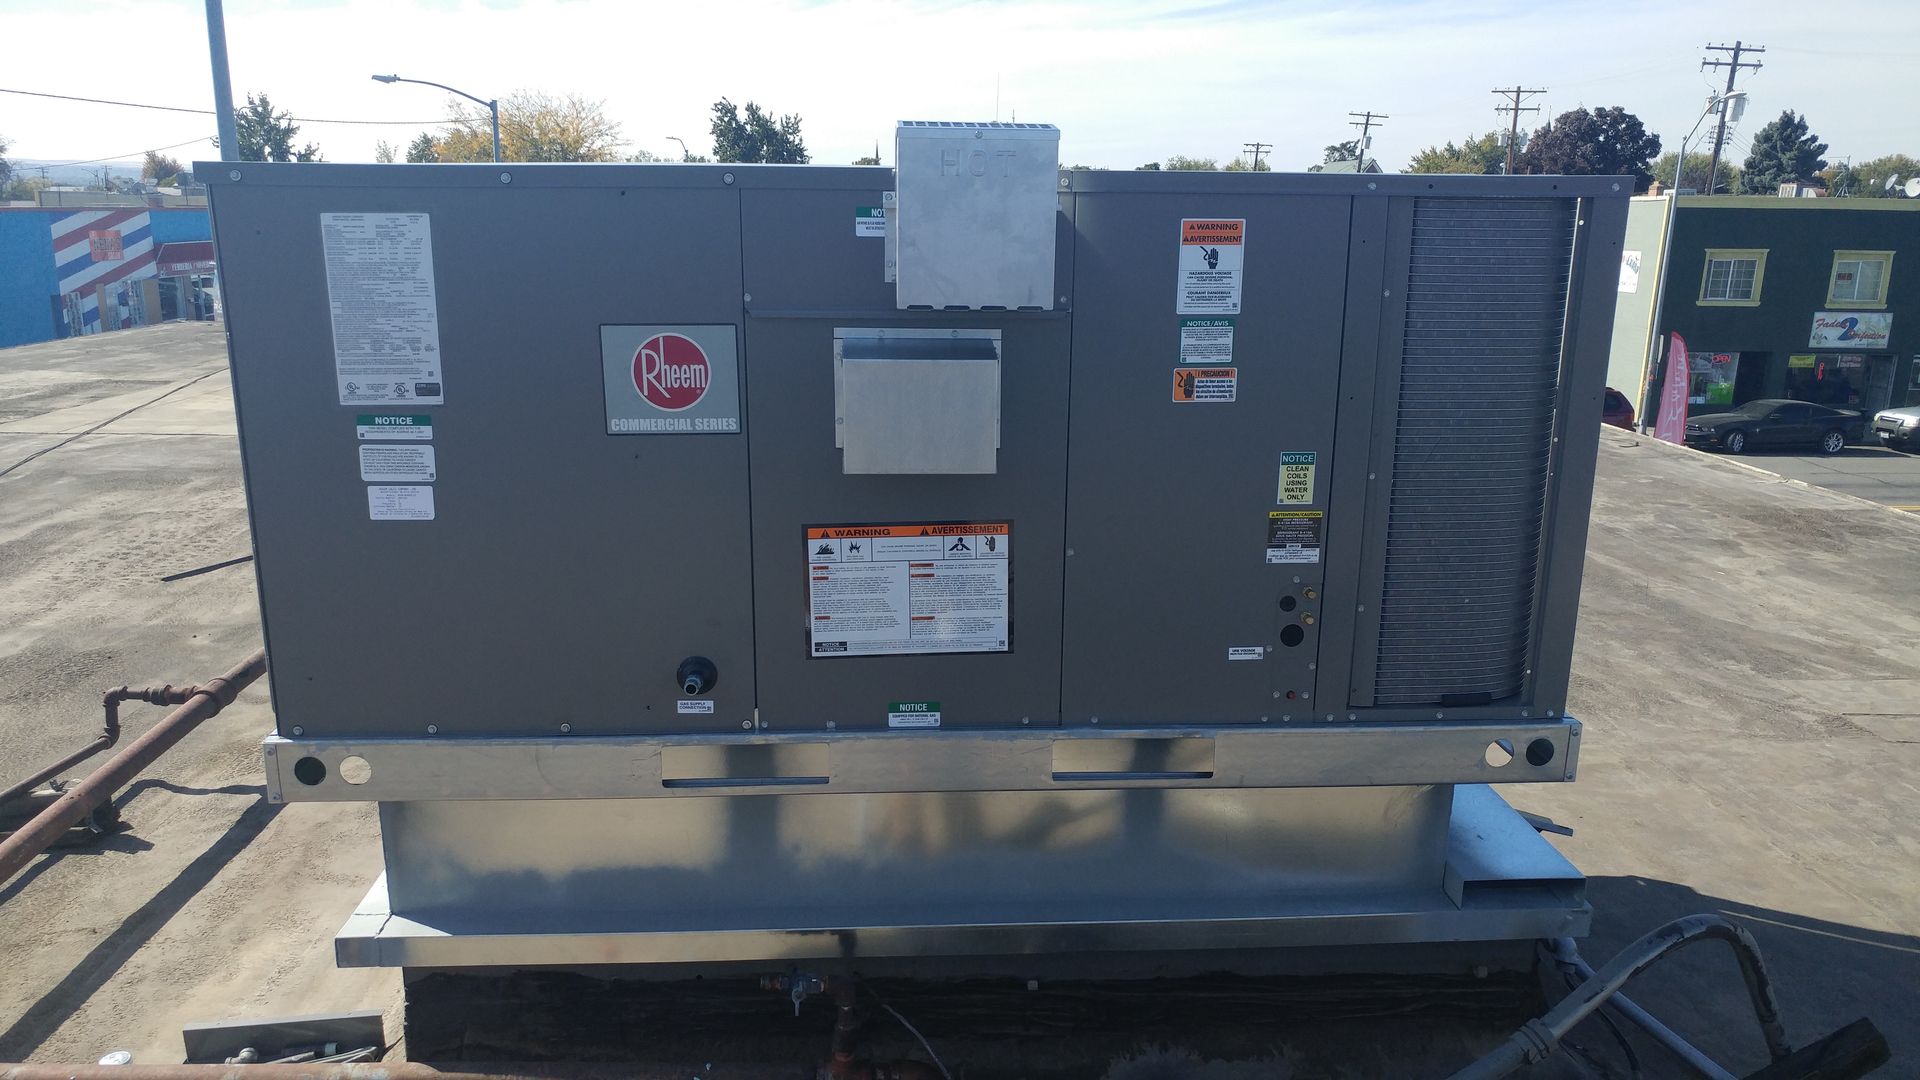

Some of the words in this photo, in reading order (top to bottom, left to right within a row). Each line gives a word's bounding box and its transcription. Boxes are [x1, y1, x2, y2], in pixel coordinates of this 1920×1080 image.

[940, 148, 1017, 178] HOT
[1197, 223, 1239, 231] WARNING
[1190, 235, 1243, 243] AVERTISSEMENT
[1837, 317, 1859, 341] 2
[641, 336, 706, 399] Rheem
[374, 416, 414, 425] NOTICE
[611, 418, 694, 432] COMMERCIAL
[694, 417, 738, 431] SERIES
[1282, 454, 1314, 463] NOTICE
[834, 528, 890, 537] WARNING
[931, 525, 1004, 535] AVERTISSEMENT
[900, 703, 928, 712] NOTICE
